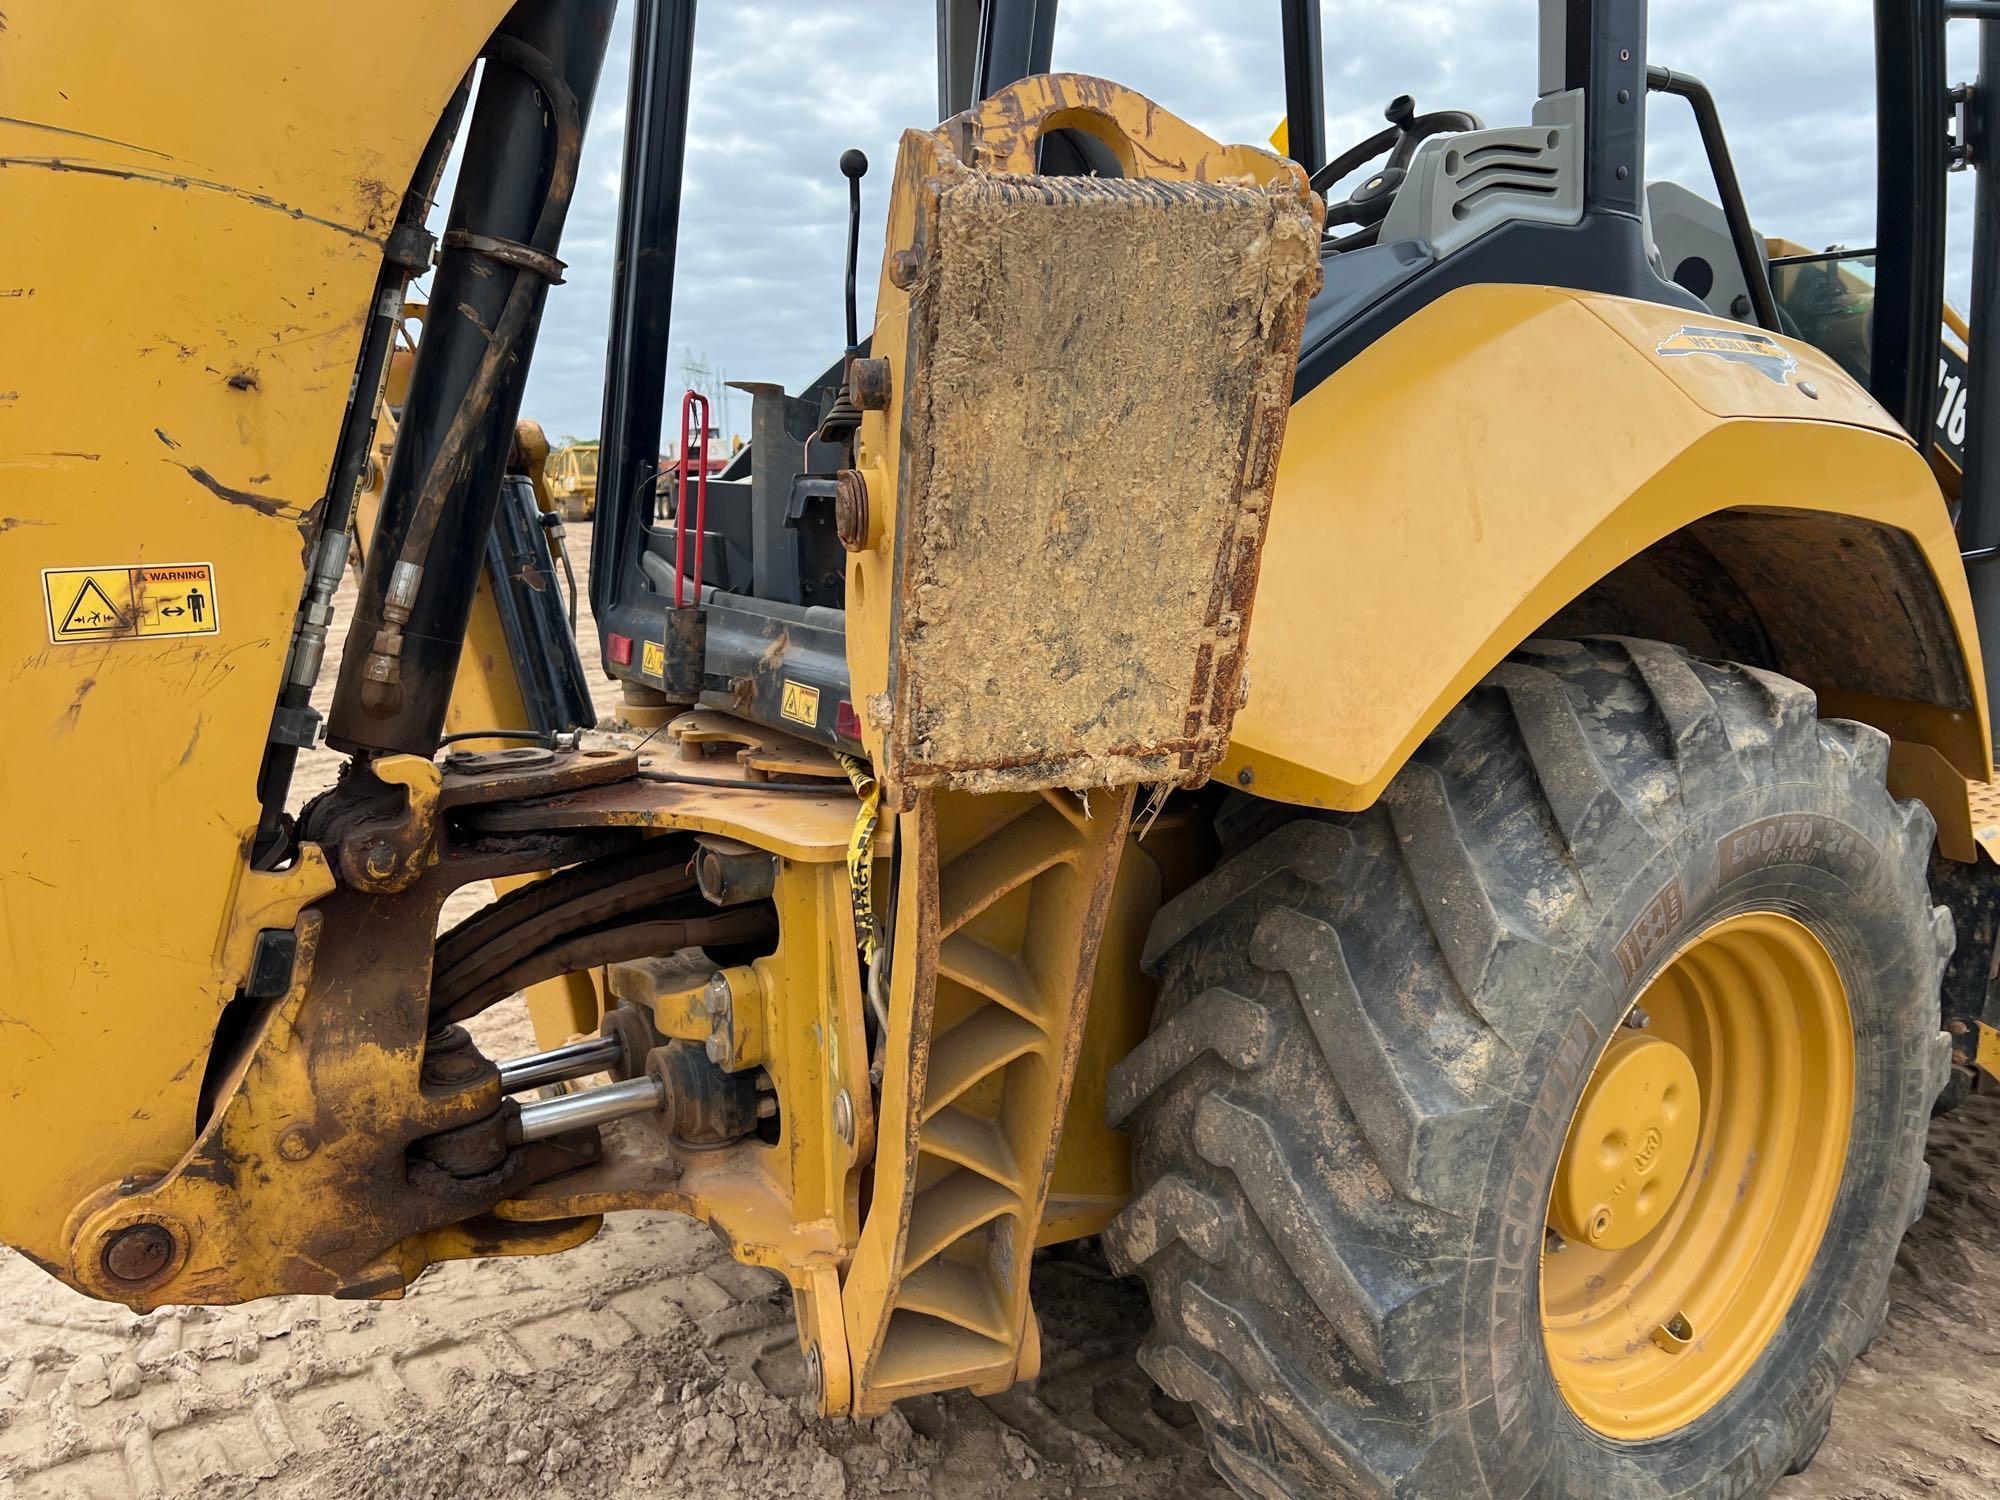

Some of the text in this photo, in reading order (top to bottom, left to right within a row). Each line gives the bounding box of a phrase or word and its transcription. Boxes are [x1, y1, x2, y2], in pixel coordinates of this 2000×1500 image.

[1687, 336, 1715, 349] WE
[1712, 339, 1749, 352] BUILD
[150, 570, 205, 581] WARNING
